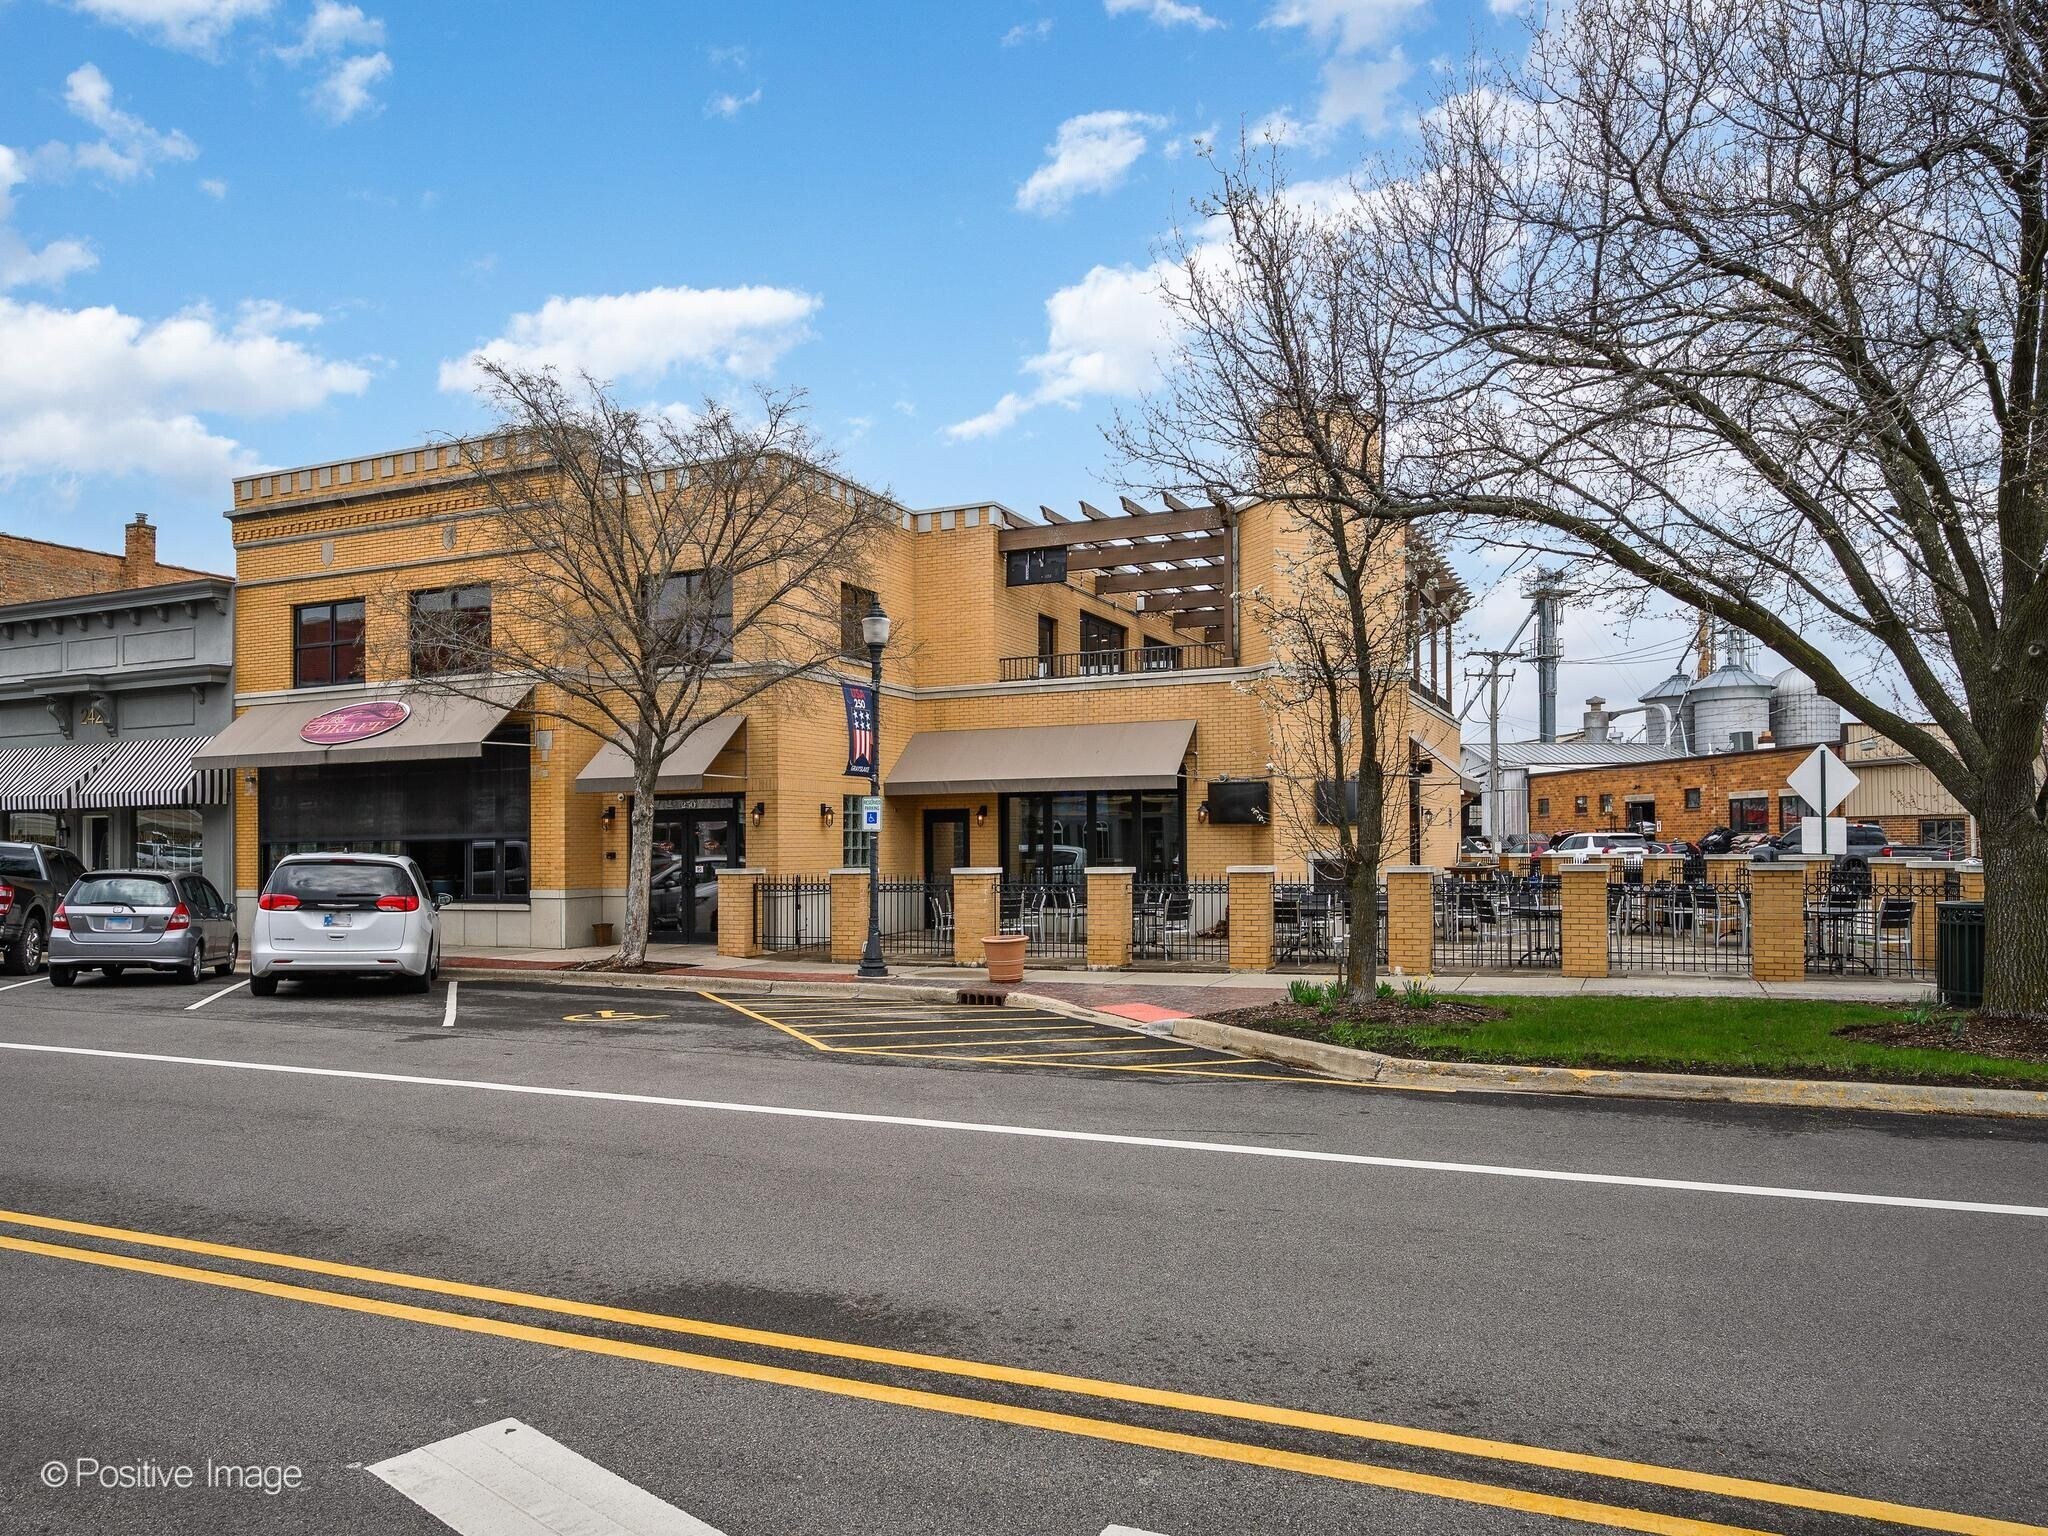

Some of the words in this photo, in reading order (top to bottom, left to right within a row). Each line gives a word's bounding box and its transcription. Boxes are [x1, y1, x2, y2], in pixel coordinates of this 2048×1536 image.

[850, 688, 866, 700] USA
[853, 698, 866, 709] 250
[80, 708, 103, 725] 242
